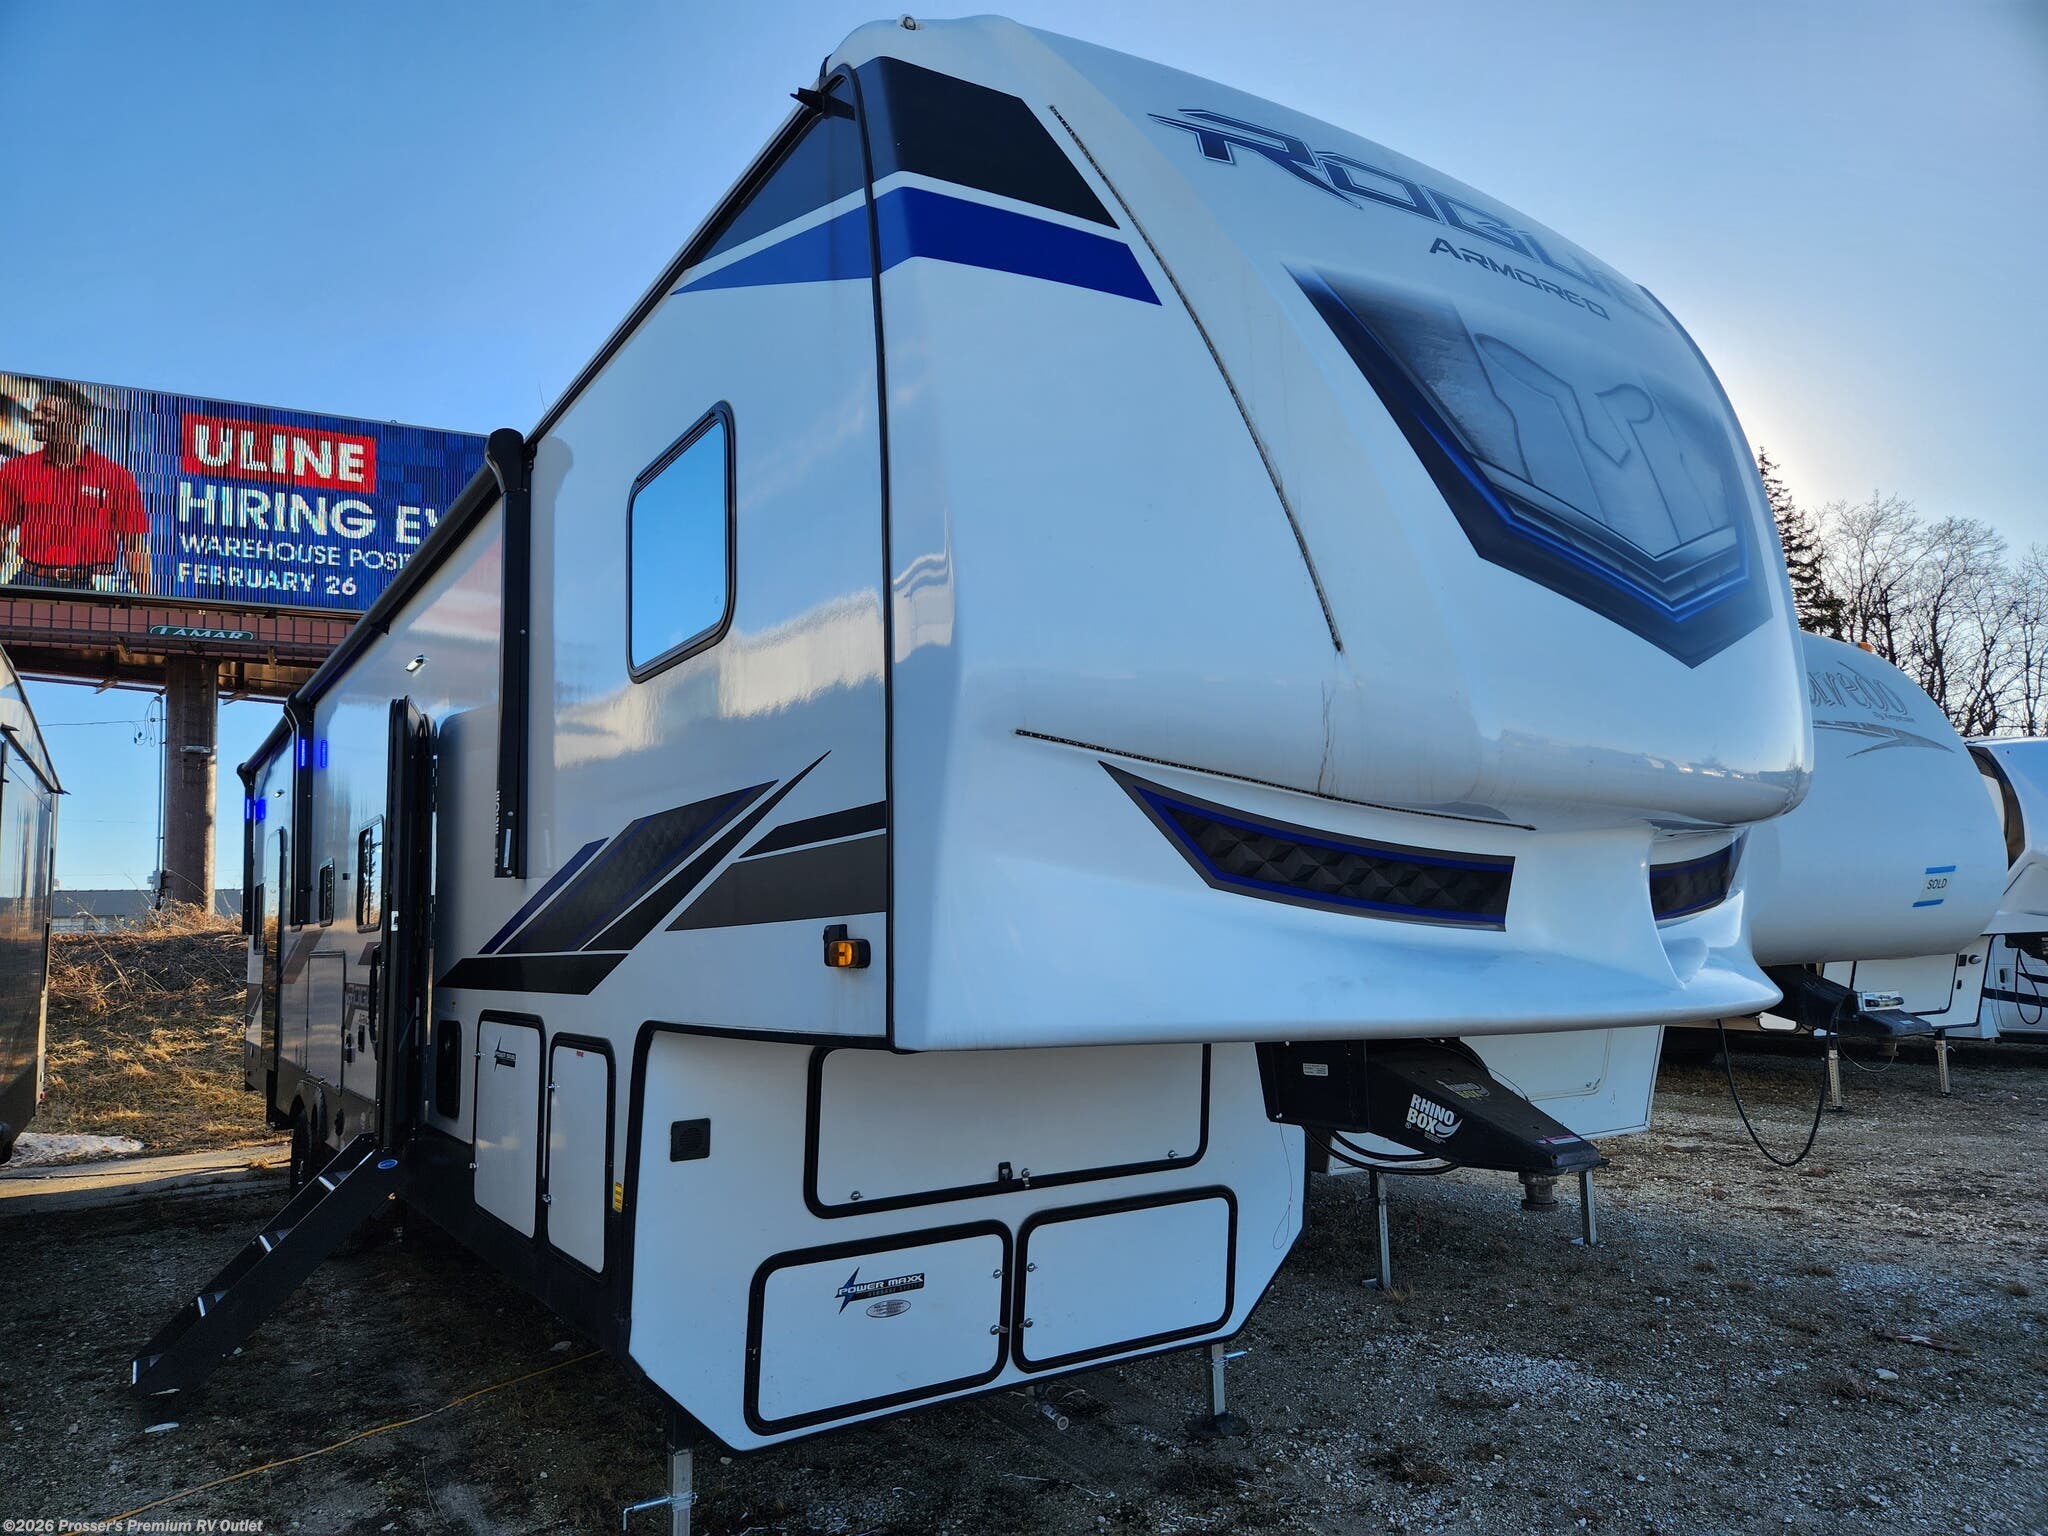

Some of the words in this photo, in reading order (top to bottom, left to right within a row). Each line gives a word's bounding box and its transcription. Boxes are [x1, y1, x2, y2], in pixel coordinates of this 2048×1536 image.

[1430, 237, 1610, 321] ARMORED
[195, 424, 365, 483] ULINE
[179, 481, 376, 539] HIRING
[179, 532, 341, 566] WAREHOUSE
[178, 562, 315, 593] FEBRUARY
[325, 575, 358, 596] 26
[1927, 878, 1948, 890] SOLD
[1406, 1106, 1438, 1135] BOX
[1410, 1093, 1455, 1126] RHINO
[839, 1281, 884, 1295] POWER
[887, 1274, 923, 1287] MAXX
